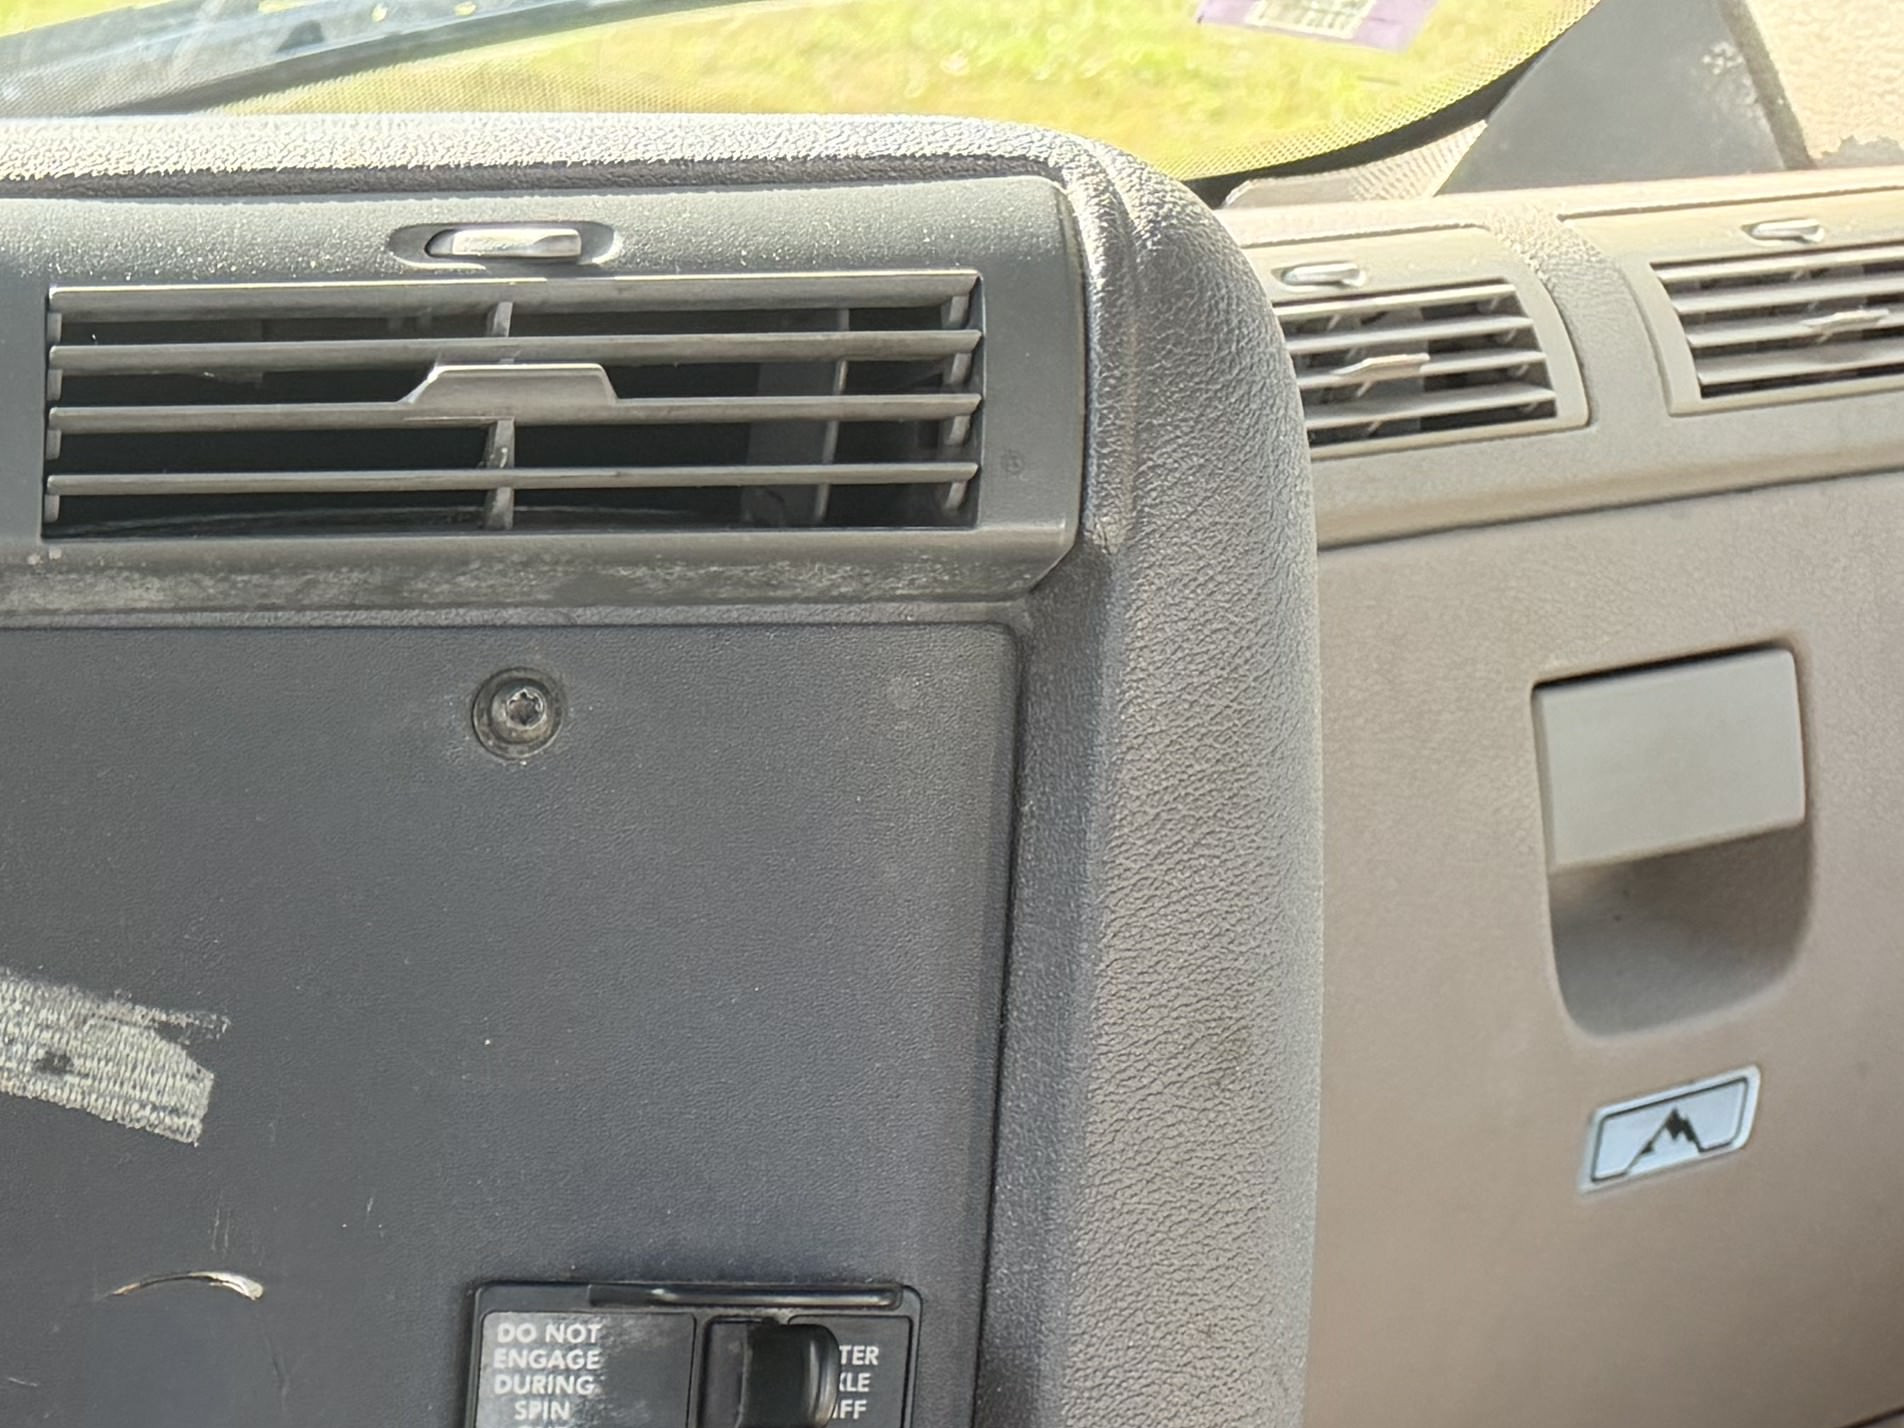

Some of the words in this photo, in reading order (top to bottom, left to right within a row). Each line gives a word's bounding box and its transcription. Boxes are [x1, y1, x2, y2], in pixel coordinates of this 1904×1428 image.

[497, 1323, 536, 1344] DO
[544, 1322, 603, 1344] NOT
[493, 1347, 601, 1370] ENGAGE
[839, 1345, 879, 1366] TER
[494, 1373, 594, 1395] DURING
[839, 1372, 871, 1392] LE
[514, 1400, 571, 1422] SPIN
